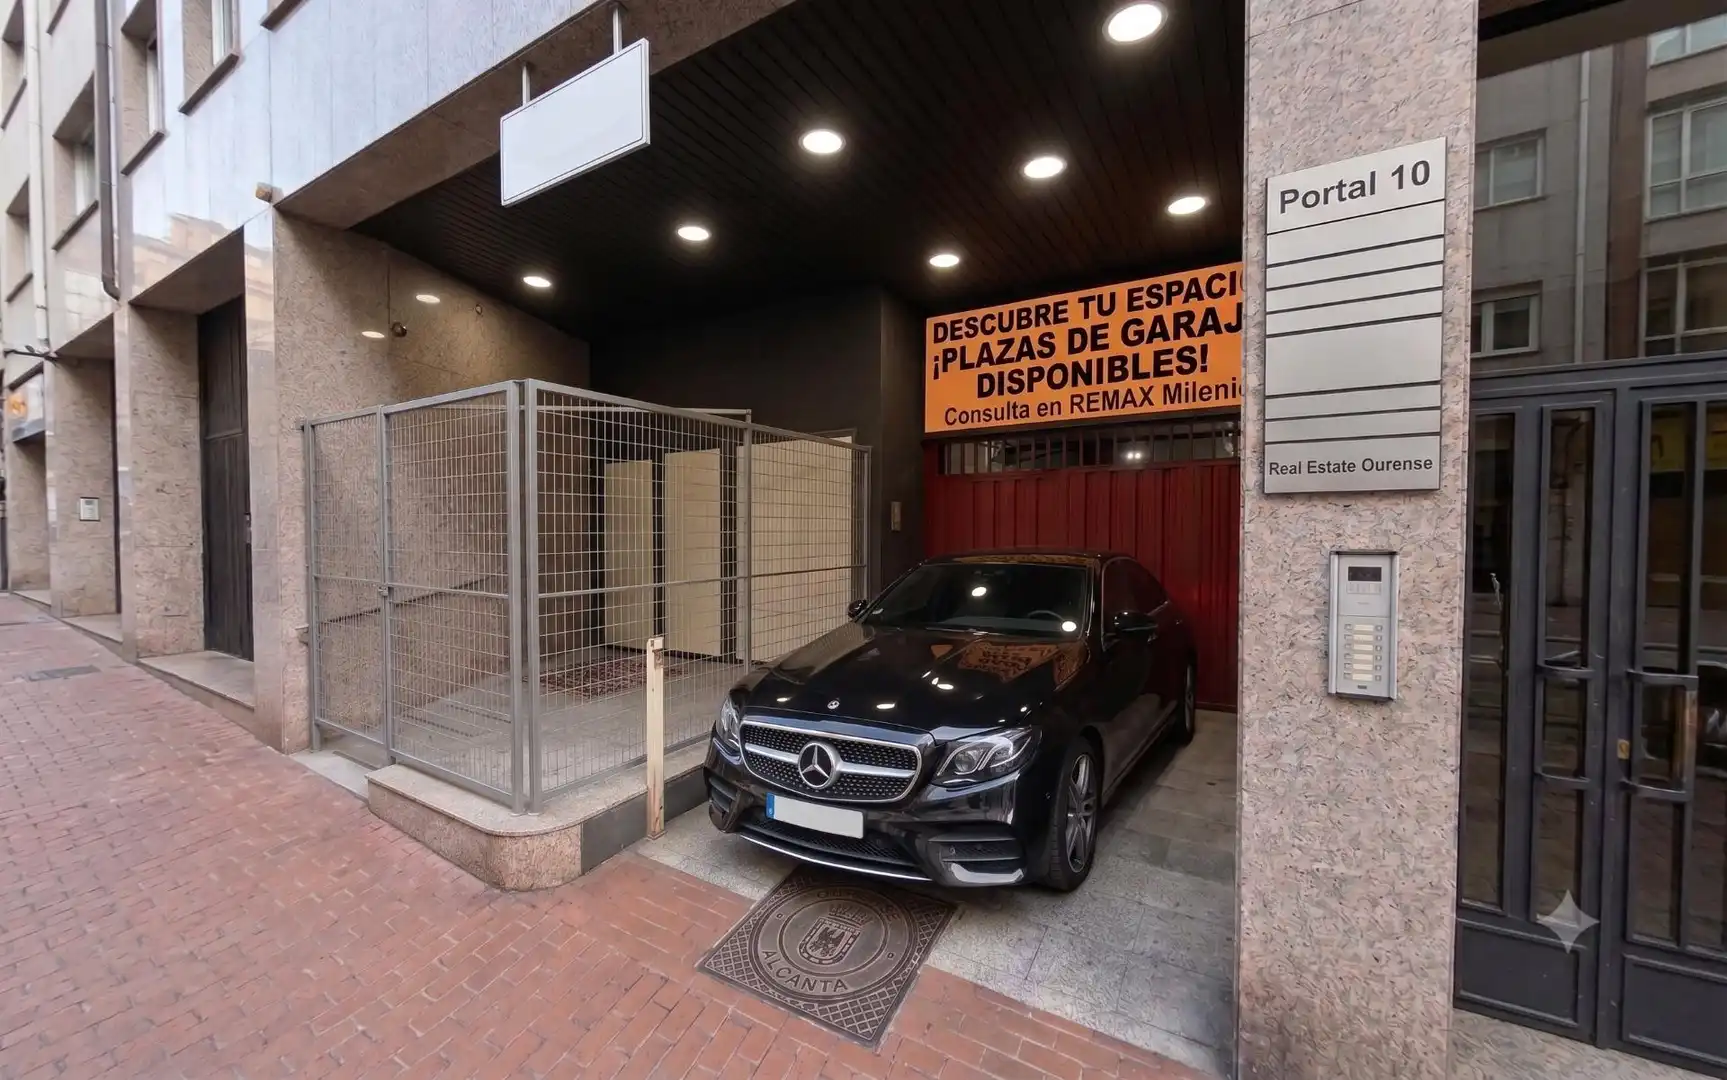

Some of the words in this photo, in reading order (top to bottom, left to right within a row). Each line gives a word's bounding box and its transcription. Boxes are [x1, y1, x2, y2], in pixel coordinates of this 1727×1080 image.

[1280, 170, 1376, 214] Portal
[1391, 160, 1430, 190] 10
[933, 300, 1068, 344] DESCUBRE
[1078, 292, 1116, 320] TU
[1127, 271, 1243, 313] ESPACI
[933, 332, 1055, 380] ¡PLAZAS
[1067, 324, 1109, 355] DE
[977, 344, 1209, 398] DISPONIBLES!
[945, 400, 1030, 426] Consulta
[1037, 401, 1062, 417] en
[1070, 385, 1154, 413] REMAX
[1269, 461, 1301, 475] Real
[1307, 460, 1356, 474] Estate
[1362, 457, 1433, 472] Ourense
[762, 950, 848, 993] ALCANTA
